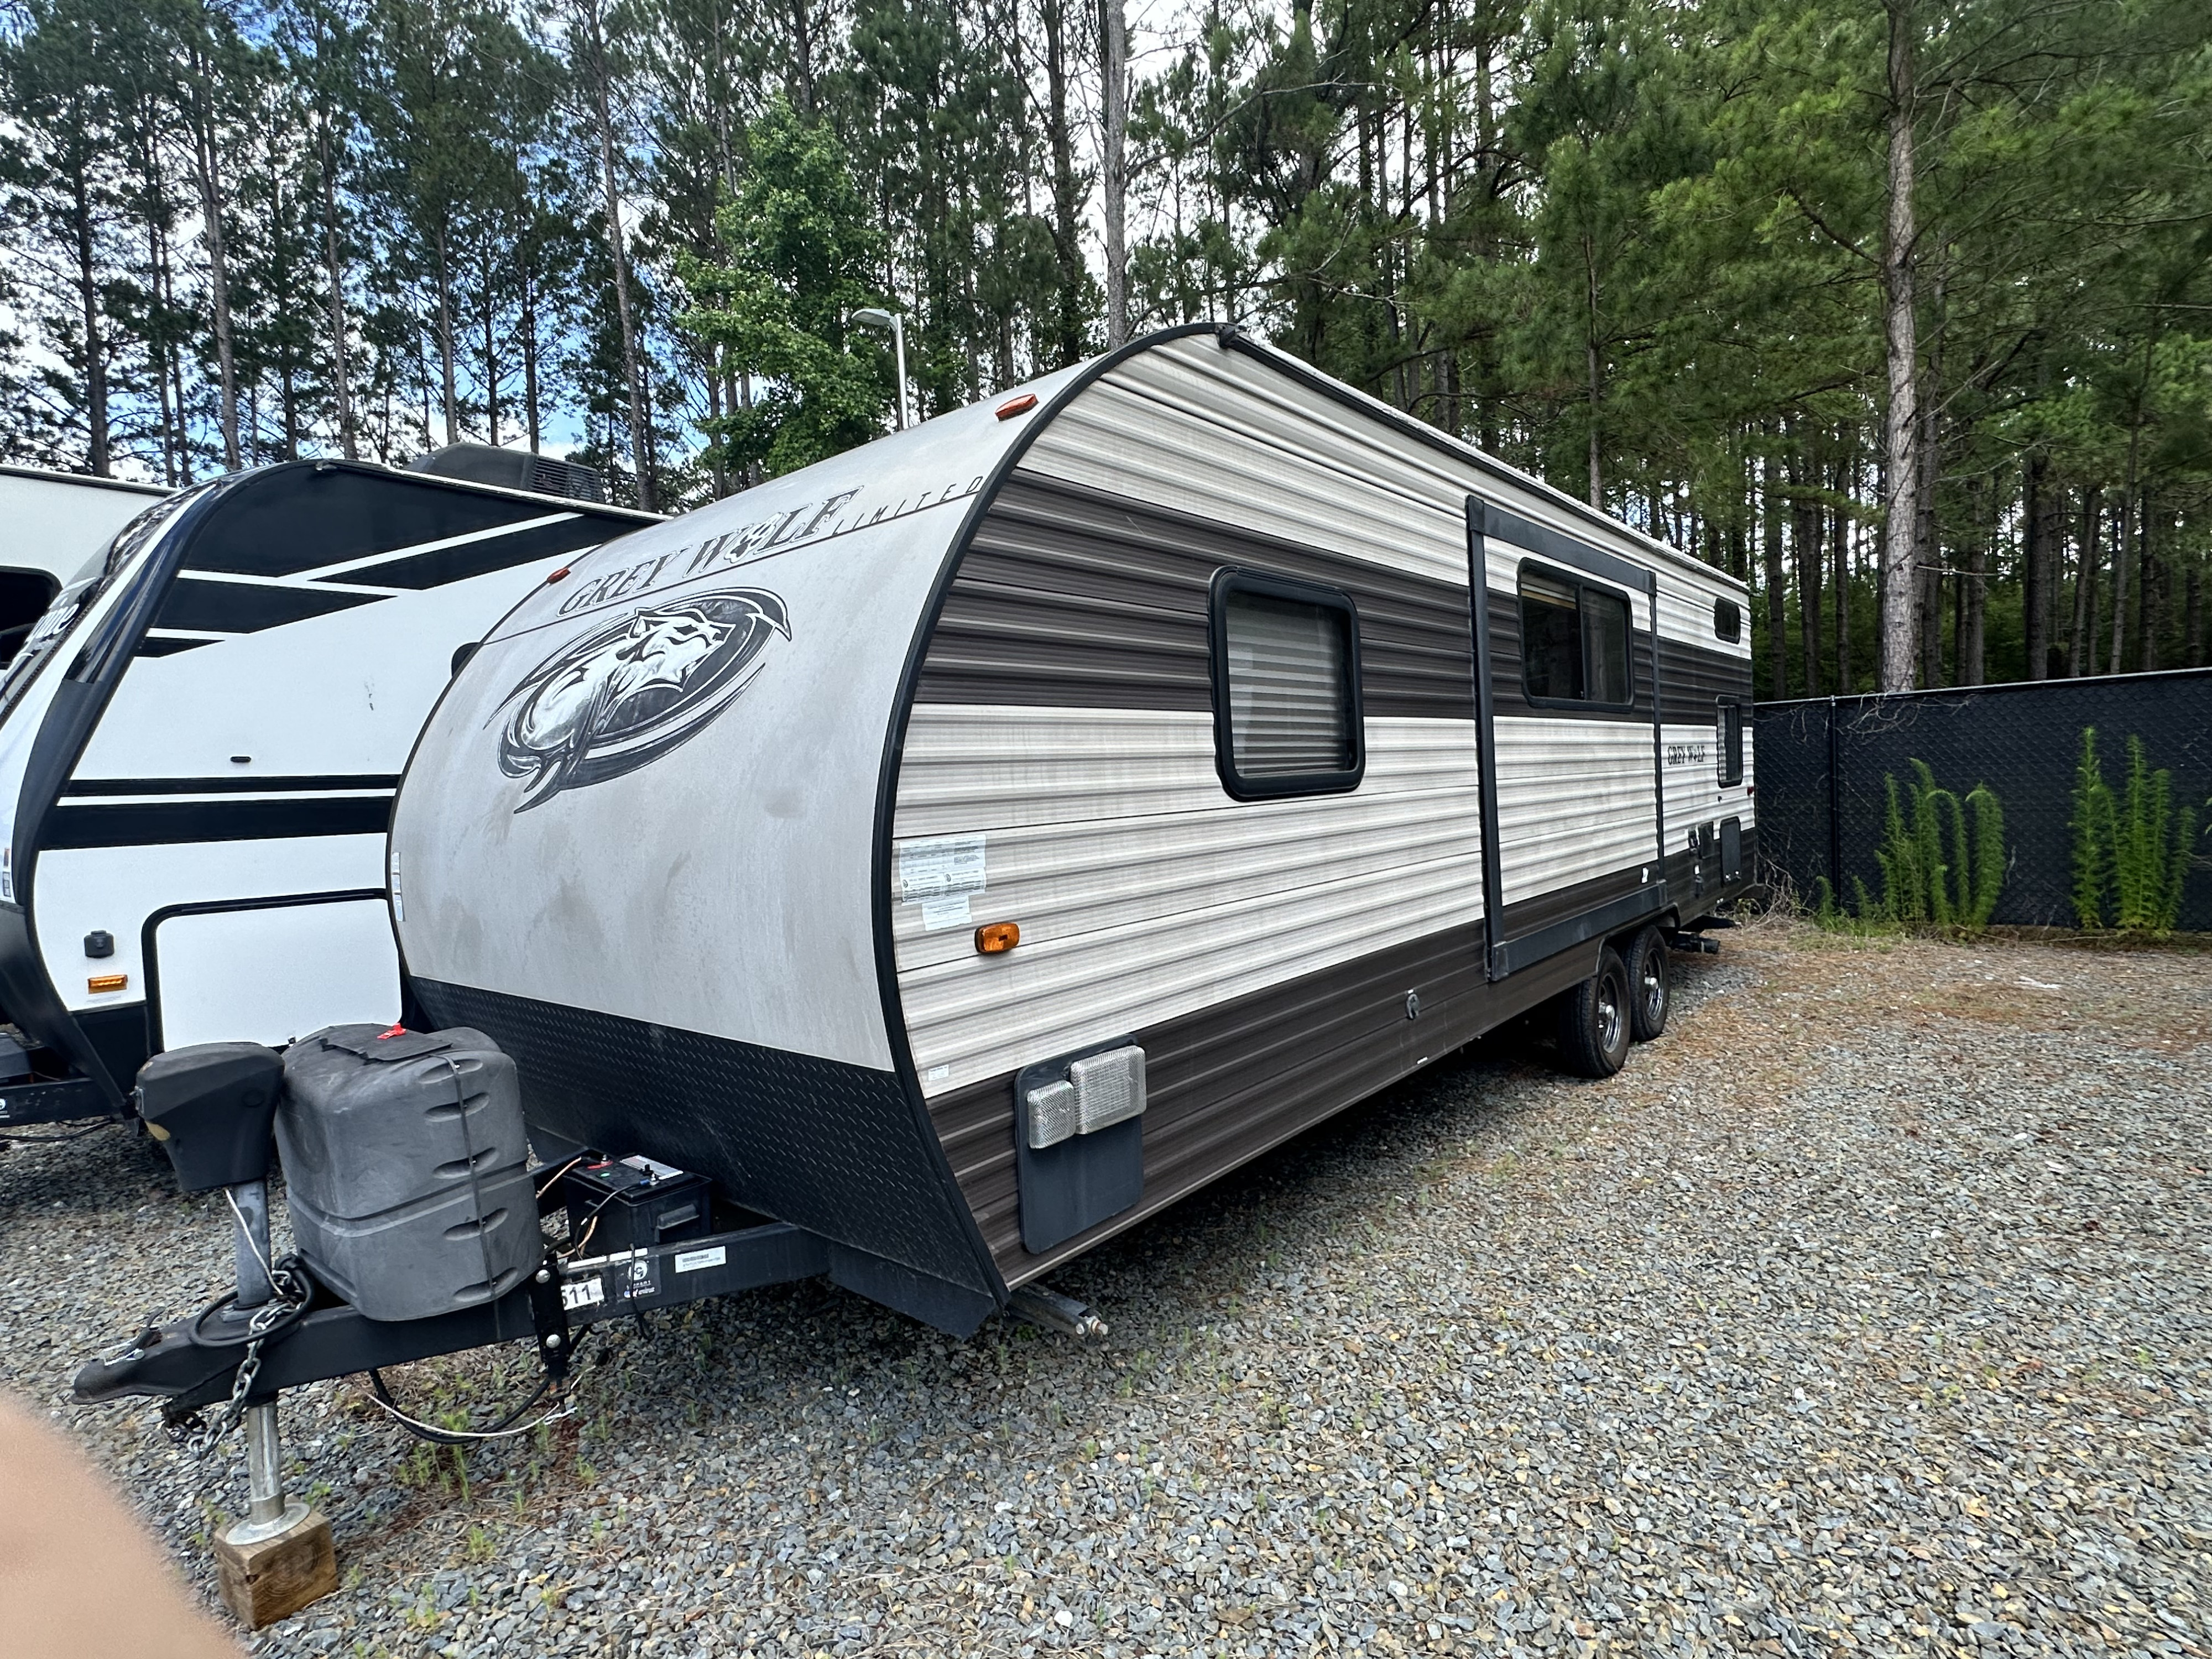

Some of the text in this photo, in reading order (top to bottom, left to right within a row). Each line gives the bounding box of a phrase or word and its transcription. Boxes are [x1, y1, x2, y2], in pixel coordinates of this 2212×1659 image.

[832, 476, 983, 536] LIMITED
[558, 486, 864, 617] GREY WOLF
[1667, 745, 1686, 765] GREY
